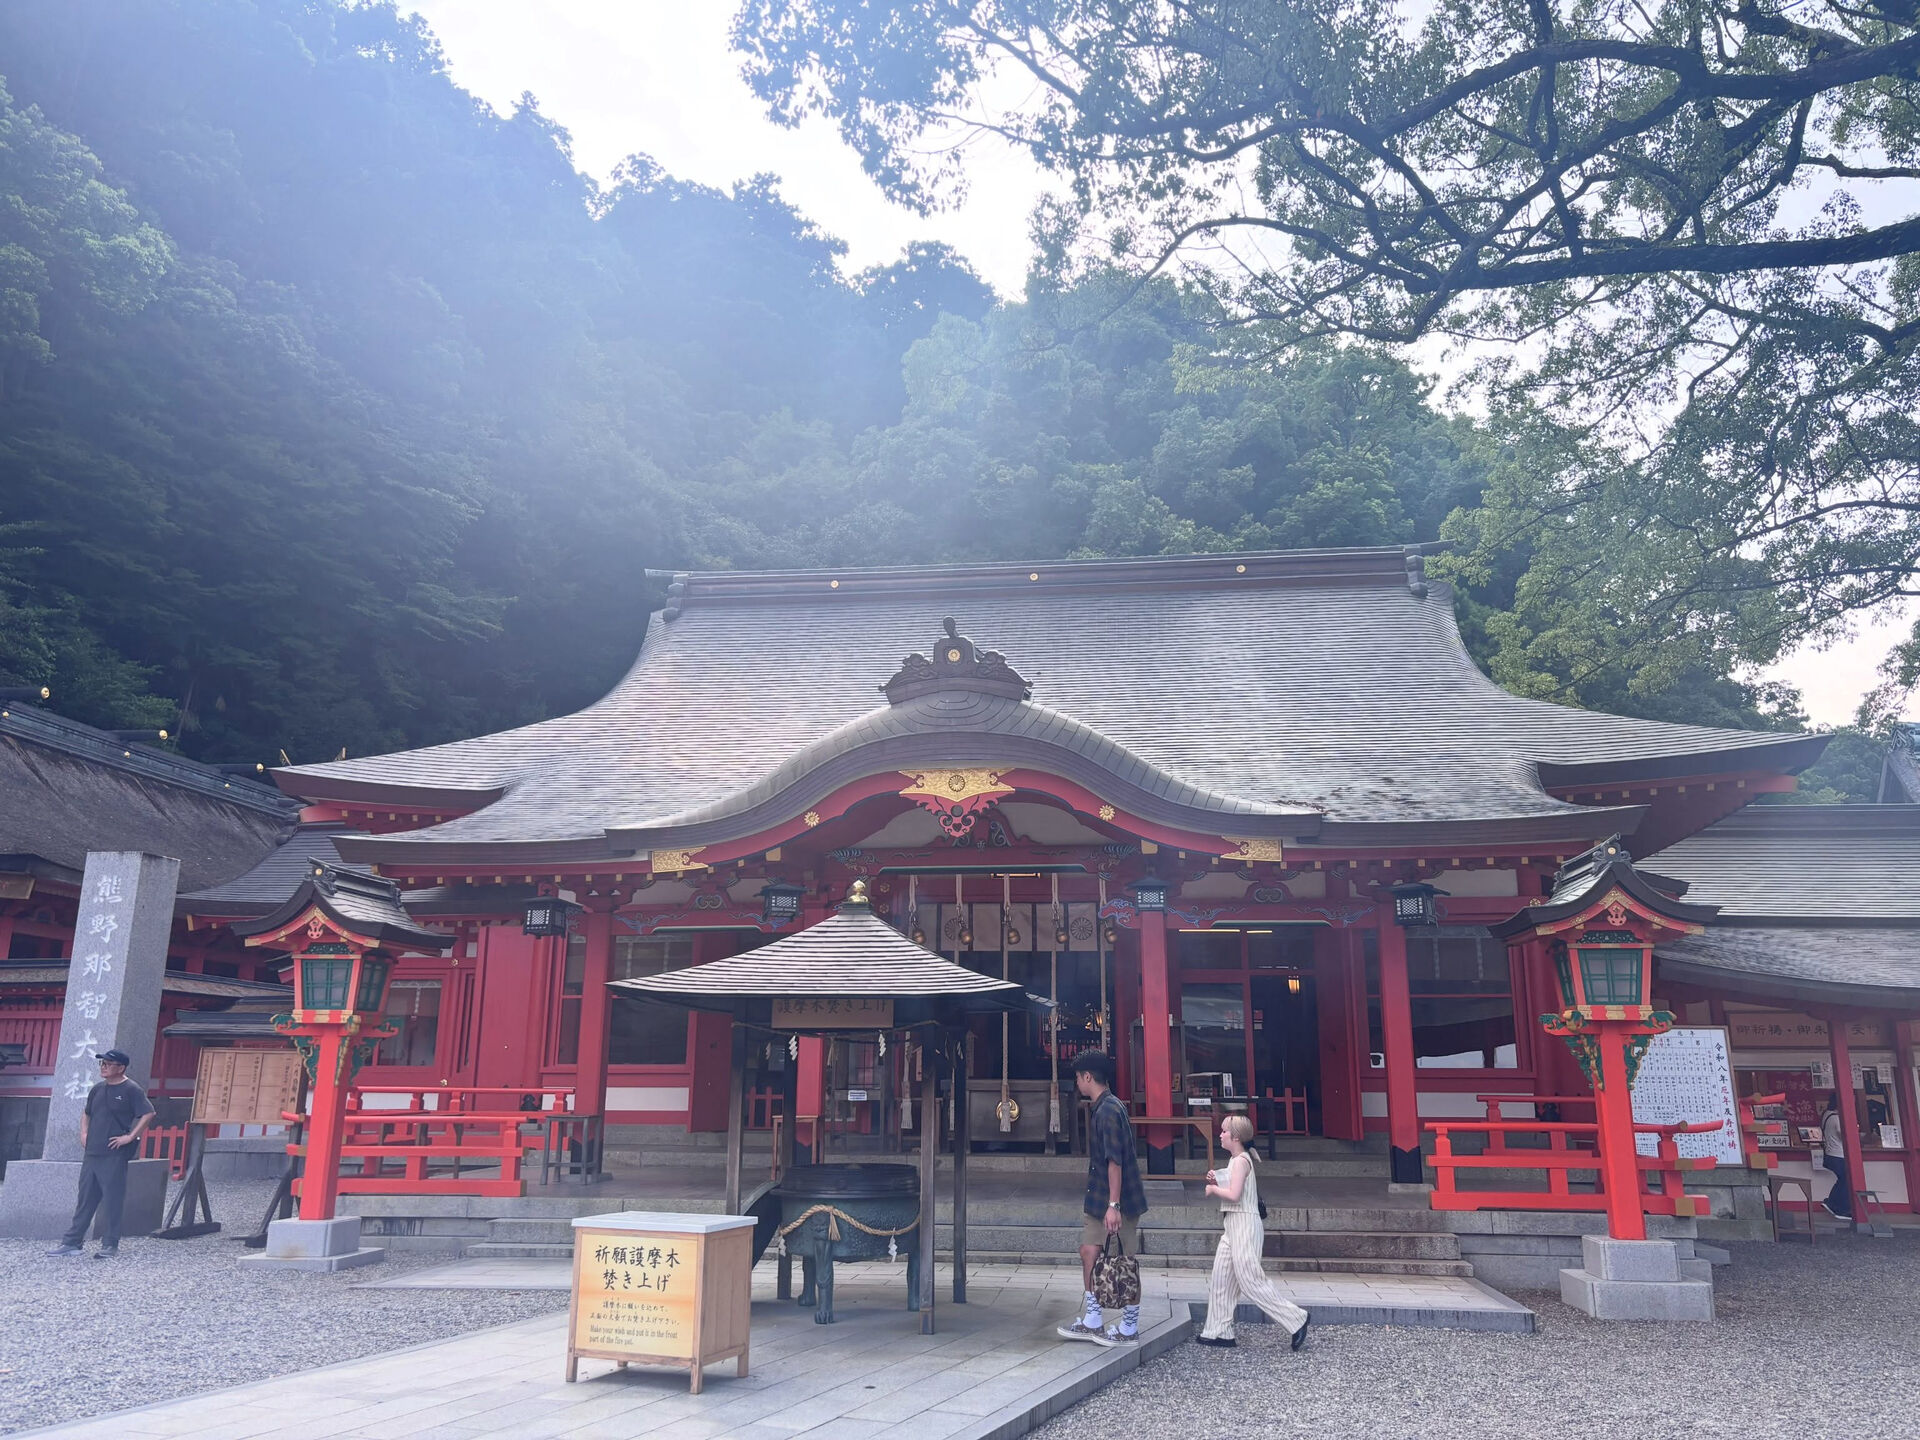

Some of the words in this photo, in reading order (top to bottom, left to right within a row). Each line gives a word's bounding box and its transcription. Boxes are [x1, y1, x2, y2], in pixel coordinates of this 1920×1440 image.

[64, 875, 122, 1101] 熊野那智大社
[595, 1244, 681, 1269] 祈願護摩木
[603, 1269, 671, 1292] 焚き上げ
[590, 1324, 601, 1333] Make
[599, 1335, 605, 1343] of
